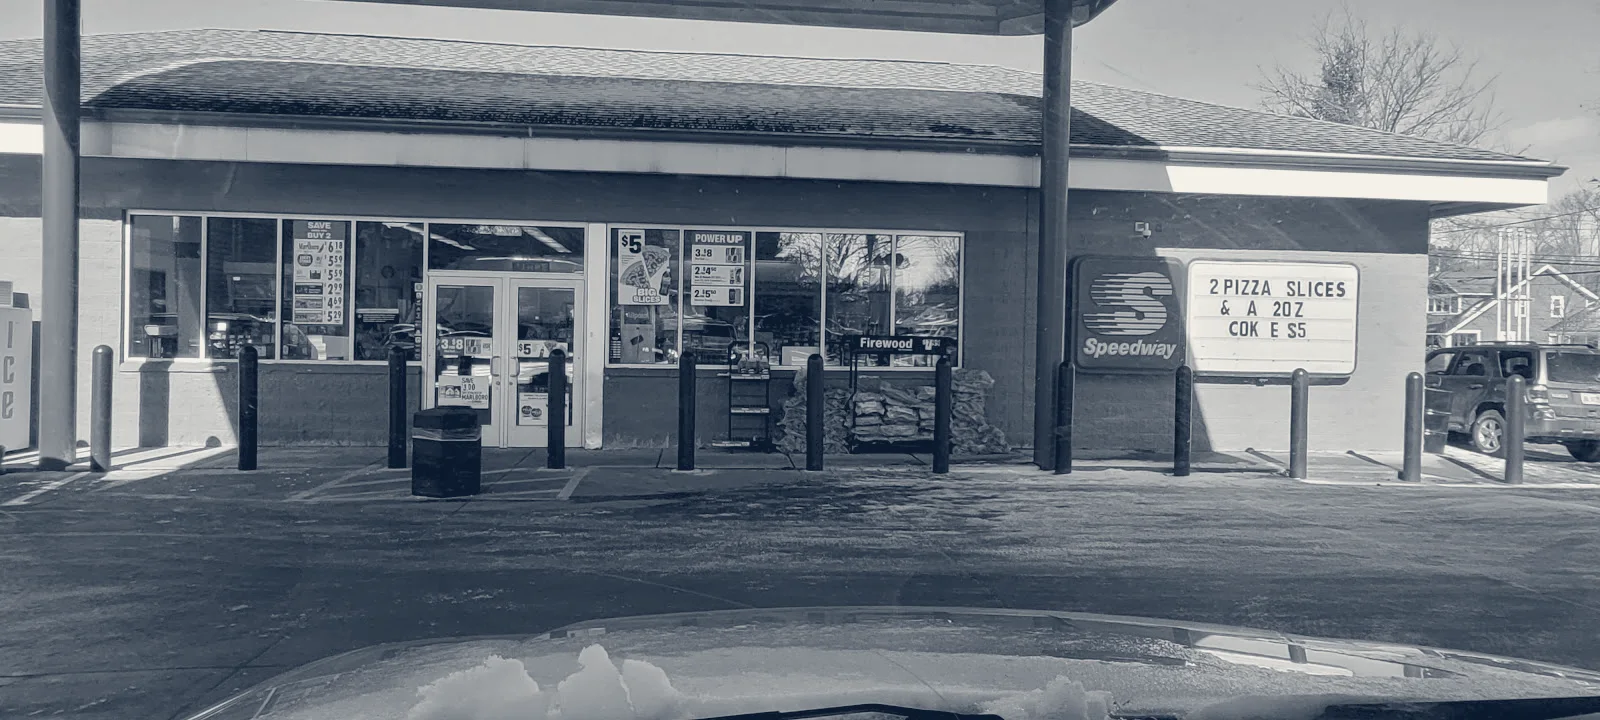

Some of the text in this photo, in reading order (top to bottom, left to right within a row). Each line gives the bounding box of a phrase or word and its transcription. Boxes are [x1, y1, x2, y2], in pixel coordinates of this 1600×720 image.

[307, 221, 332, 230] SAVE
[621, 234, 642, 254] $5
[695, 233, 743, 244] POWER UP
[637, 287, 657, 297] BIG
[1223, 278, 1272, 297] PIZZA
[1286, 280, 1346, 298] SLICES
[632, 294, 662, 303] SLICES
[1220, 299, 1230, 316] &
[1246, 300, 1257, 317] A
[440, 338, 449, 350] 3
[518, 343, 532, 355] $5
[859, 337, 914, 350] Firewood
[1082, 337, 1178, 360] Speedway
